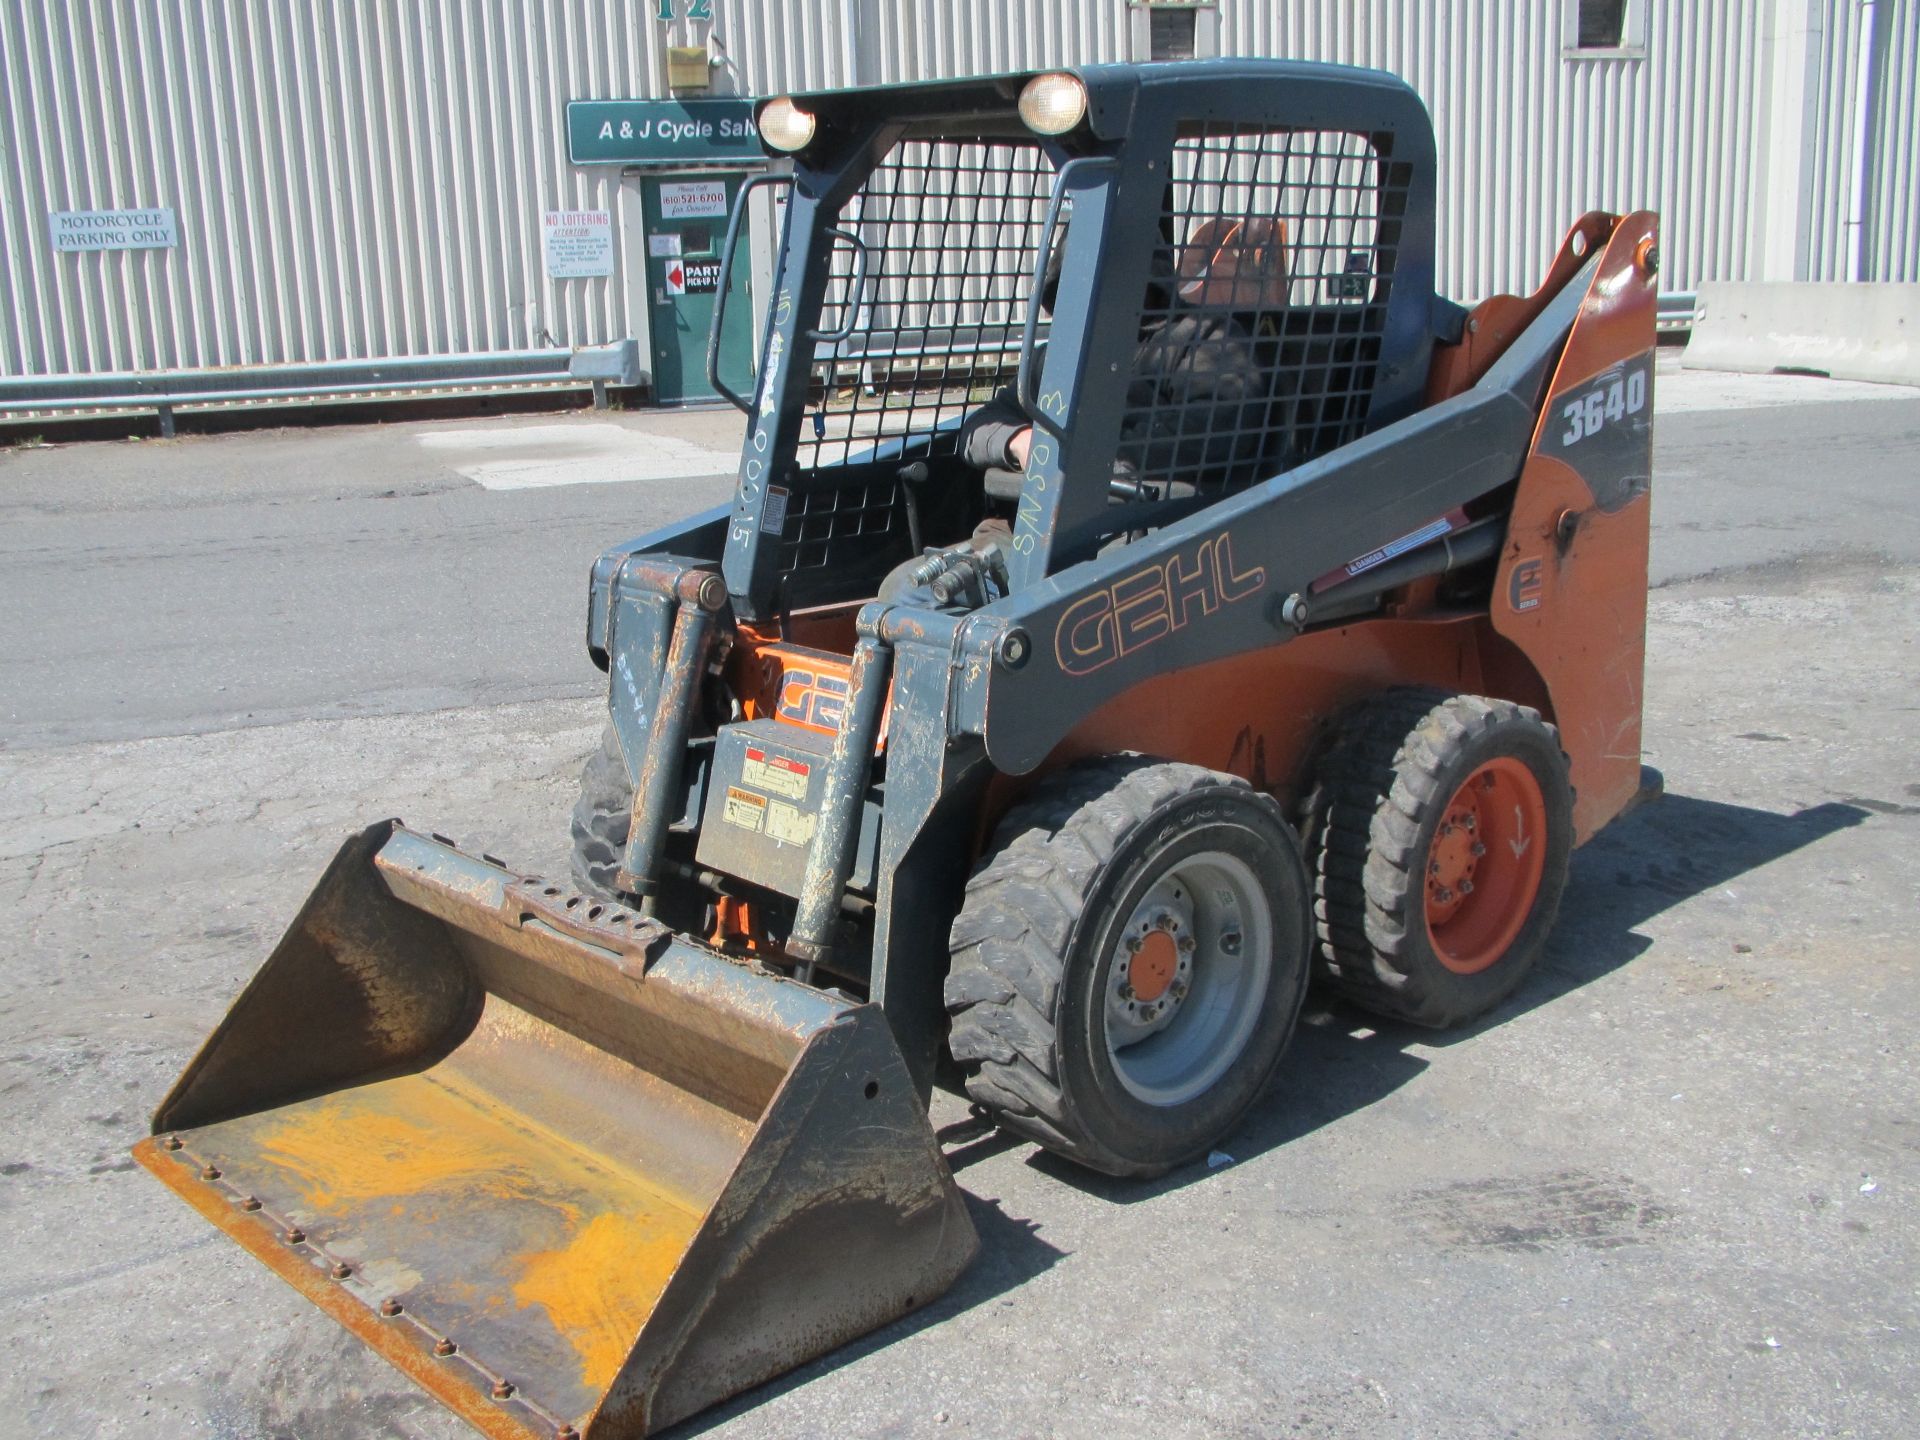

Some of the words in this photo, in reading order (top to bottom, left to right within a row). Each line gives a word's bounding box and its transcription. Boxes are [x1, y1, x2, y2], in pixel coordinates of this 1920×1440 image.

[598, 121, 614, 140] A
[619, 121, 634, 139] &
[639, 120, 651, 138] J
[657, 119, 713, 142] Cycle
[60, 213, 163, 229] MOTORCYCLE
[545, 214, 558, 226] NO
[562, 213, 609, 226] LOITERING
[58, 231, 126, 246] PARKING
[132, 229, 171, 243] ONLY
[686, 277, 711, 287] PICK-UP
[1562, 367, 1646, 447] 3640
[1055, 531, 1266, 676] GEHL
[737, 791, 762, 805] WARNING
